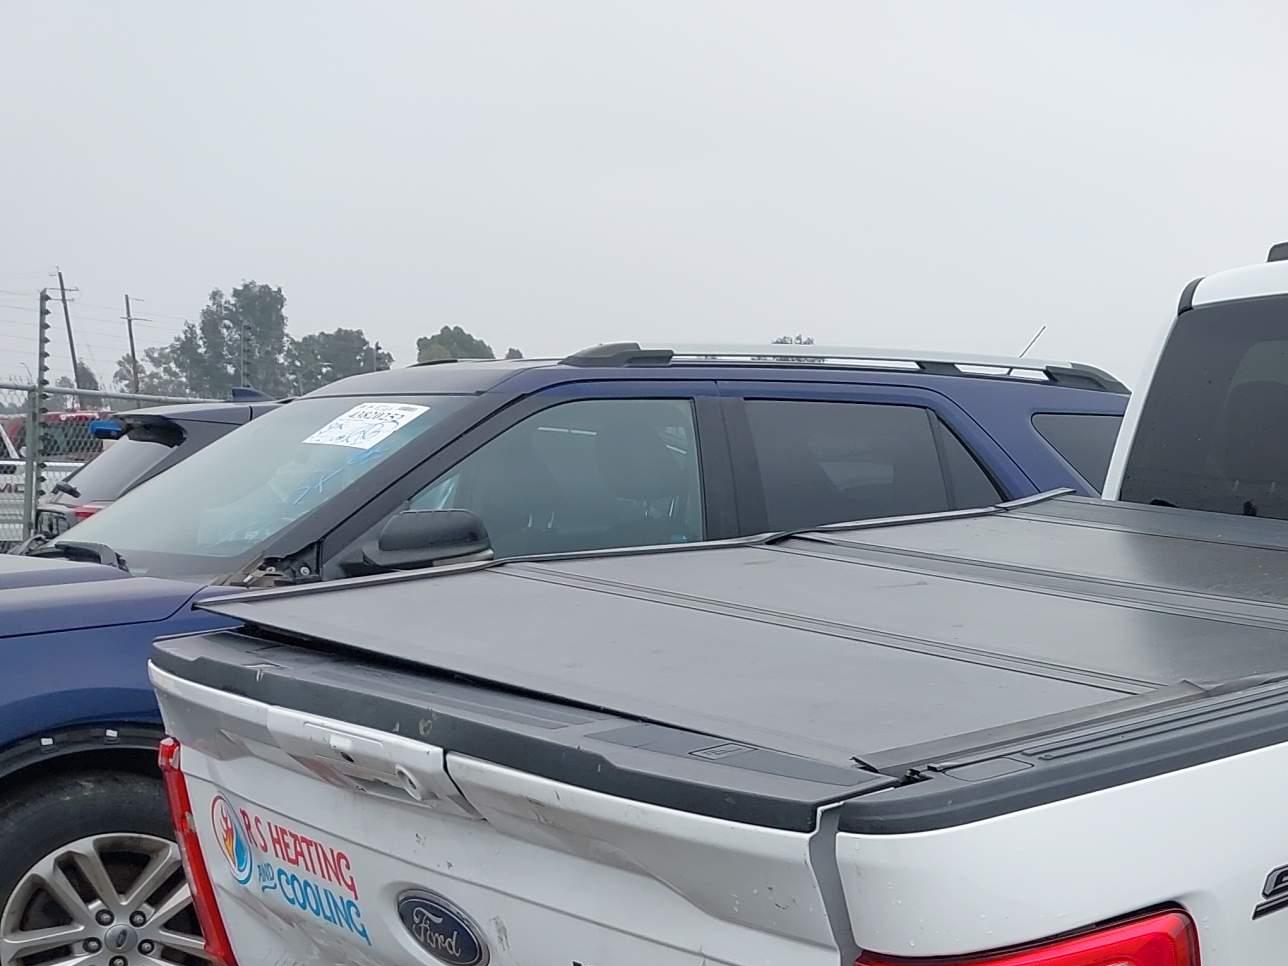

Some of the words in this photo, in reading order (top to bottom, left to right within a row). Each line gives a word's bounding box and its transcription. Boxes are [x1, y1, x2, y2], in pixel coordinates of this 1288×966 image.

[240, 808, 258, 847] R
[255, 815, 268, 853] S
[267, 821, 359, 901] HEATING
[276, 867, 372, 946] COOLING
[412, 906, 461, 957] Ford
